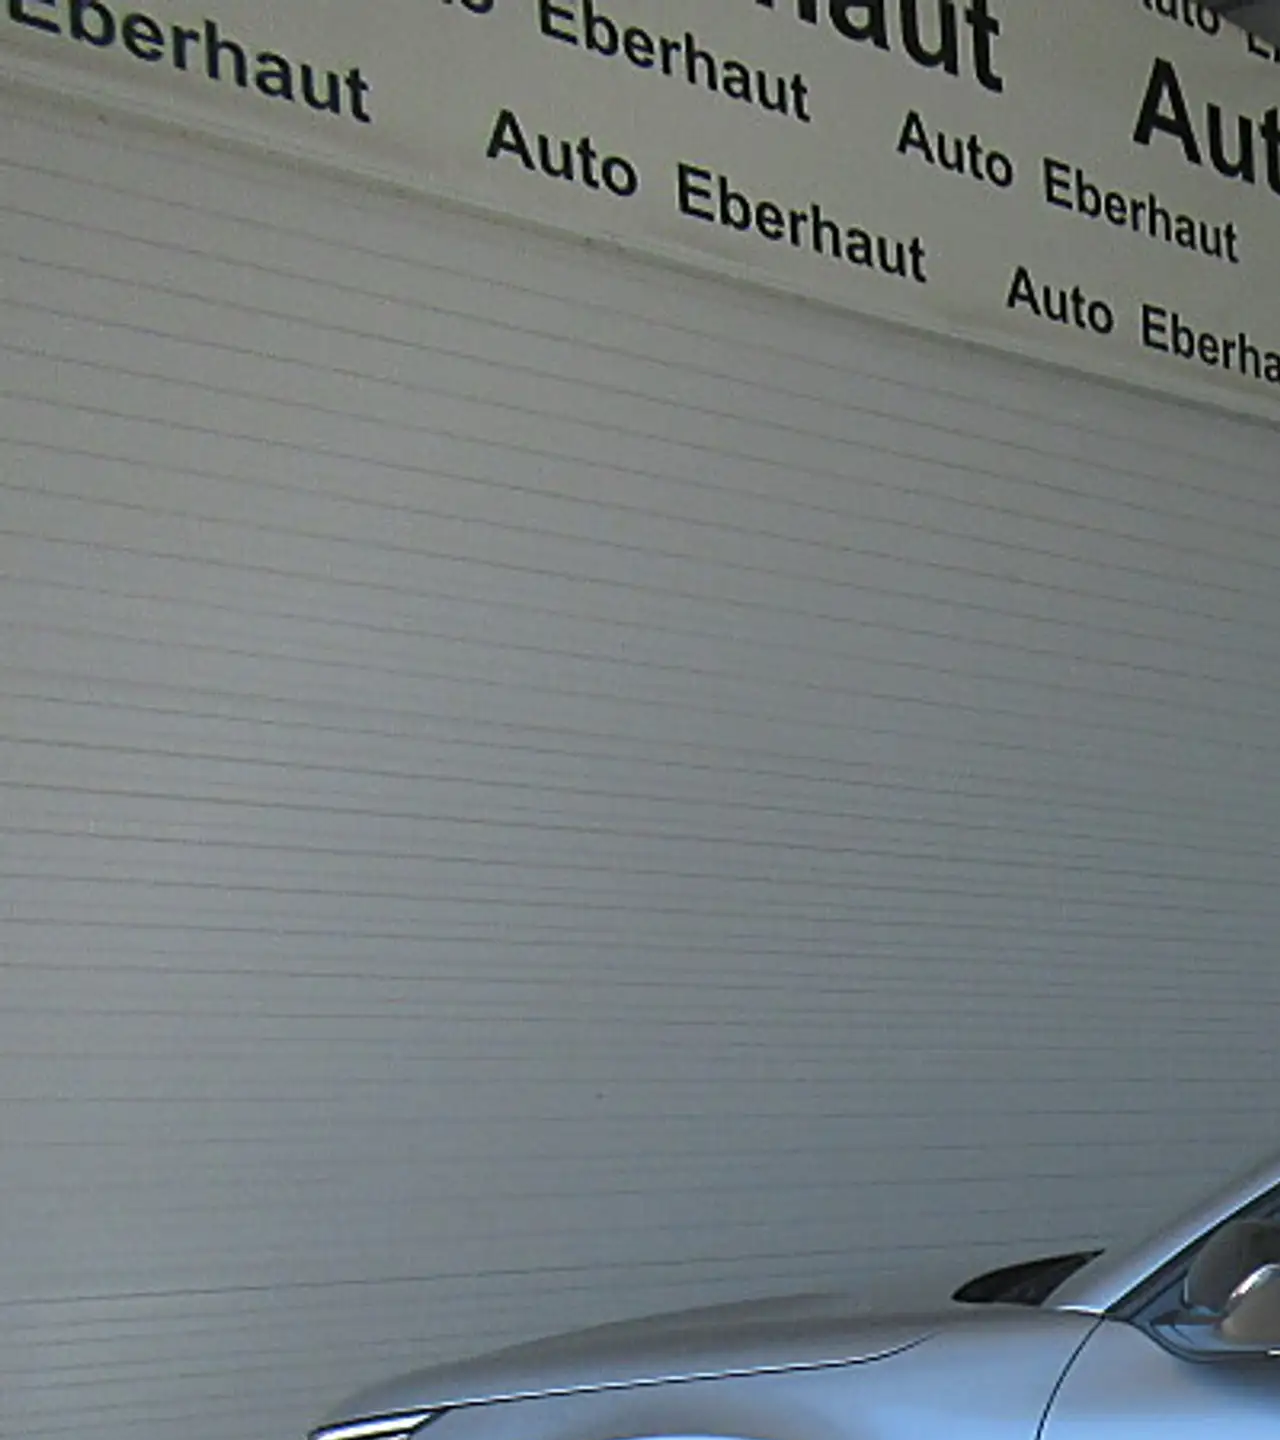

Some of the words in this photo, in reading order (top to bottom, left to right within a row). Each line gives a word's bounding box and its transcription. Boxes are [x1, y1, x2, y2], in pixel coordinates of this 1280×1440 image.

[538, 0, 810, 123] Eberhaut
[486, 109, 638, 197] Auto
[676, 162, 927, 283] Eberhaut
[896, 109, 1013, 188] Auto
[1043, 157, 1239, 264] Eberhaut
[1007, 266, 1114, 334] Auto
